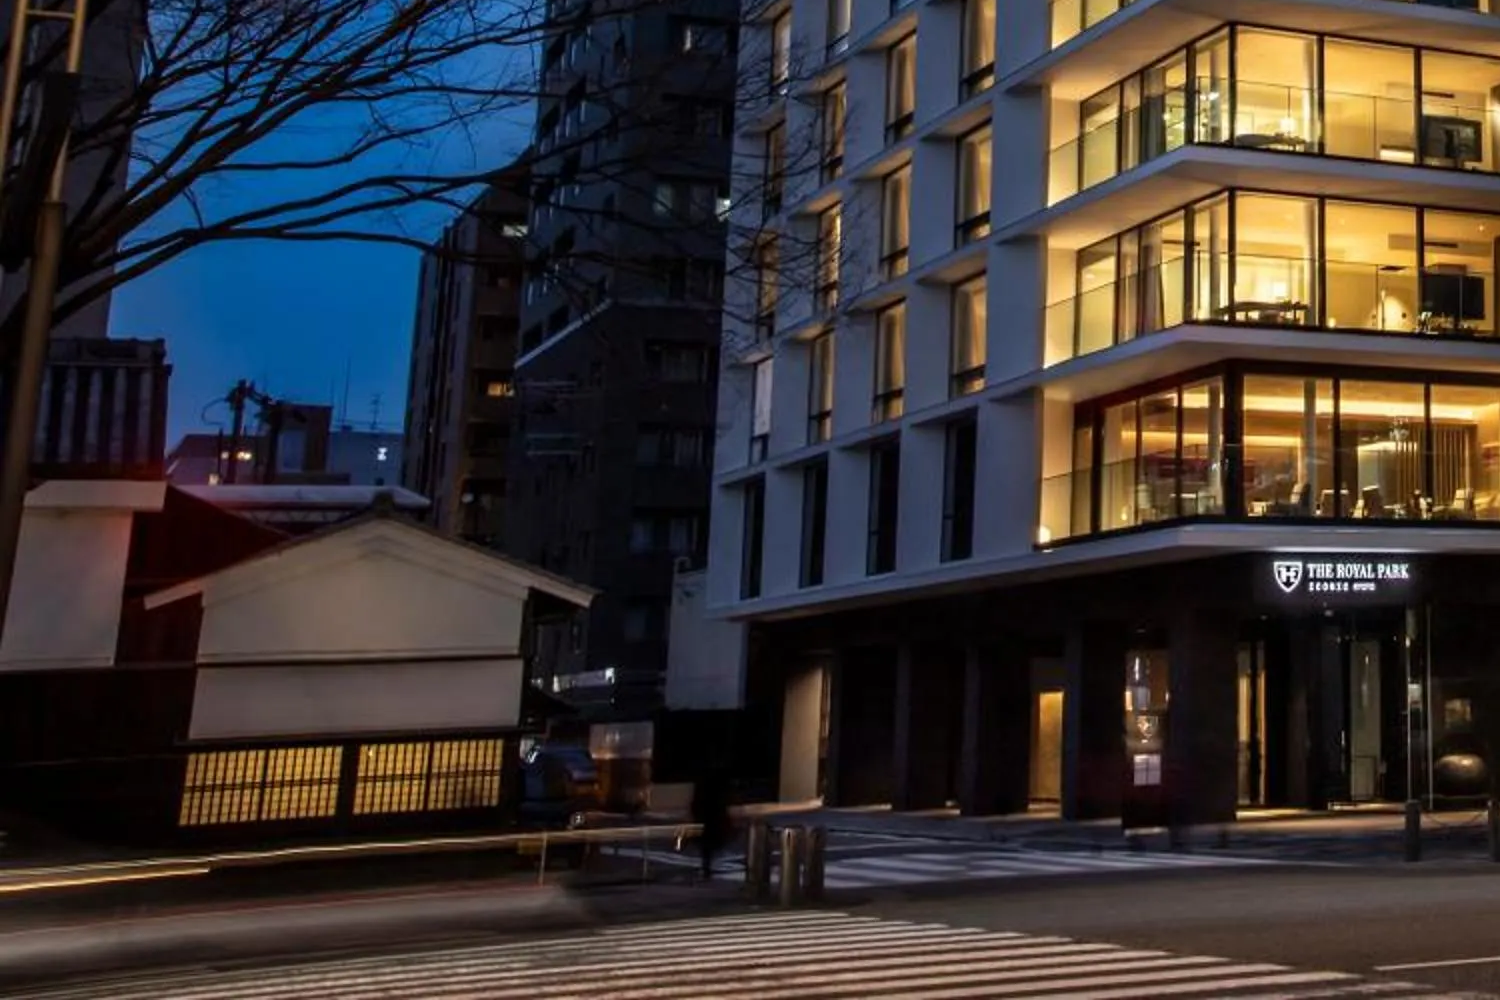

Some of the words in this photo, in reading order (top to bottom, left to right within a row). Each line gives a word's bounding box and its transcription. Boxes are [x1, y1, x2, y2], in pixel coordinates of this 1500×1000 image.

[1307, 563, 1334, 578] THE
[1336, 563, 1375, 578] ROYAL
[1377, 563, 1409, 578] PARK
